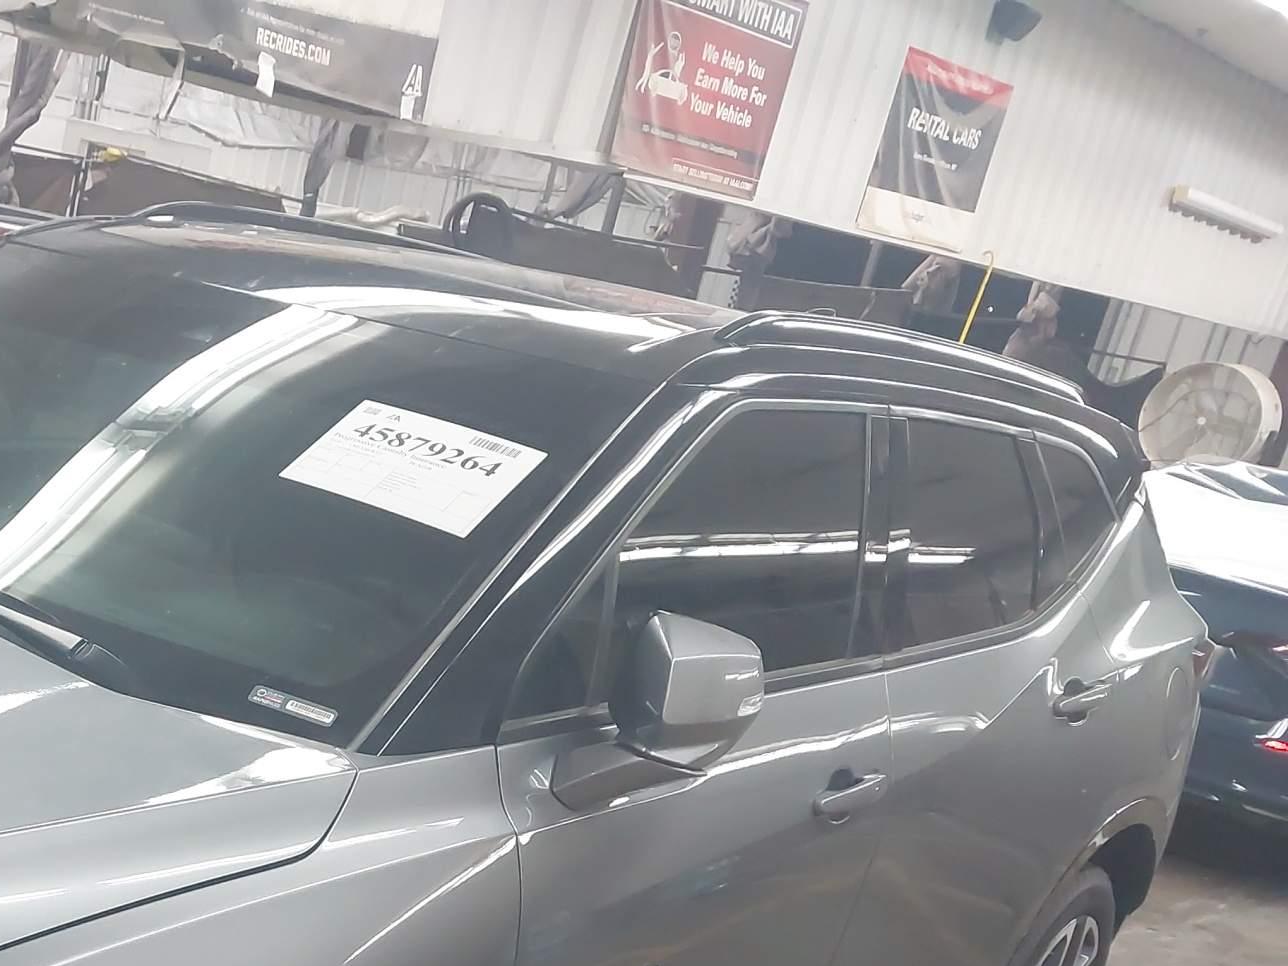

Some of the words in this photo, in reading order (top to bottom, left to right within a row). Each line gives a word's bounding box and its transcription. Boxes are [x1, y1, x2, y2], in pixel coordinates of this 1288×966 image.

[770, 8, 795, 41] IAA
[256, 27, 331, 66] RECRIDES.COM
[702, 42, 719, 64] We
[720, 50, 745, 77] Help
[747, 57, 765, 81] You
[695, 68, 720, 92] Earn
[721, 77, 749, 101] More
[750, 85, 767, 107] For
[689, 93, 714, 116] Your
[715, 101, 753, 128] Vehicle
[907, 107, 950, 141] RENTAL
[952, 127, 982, 150] CARS
[353, 424, 503, 477] 45879264
